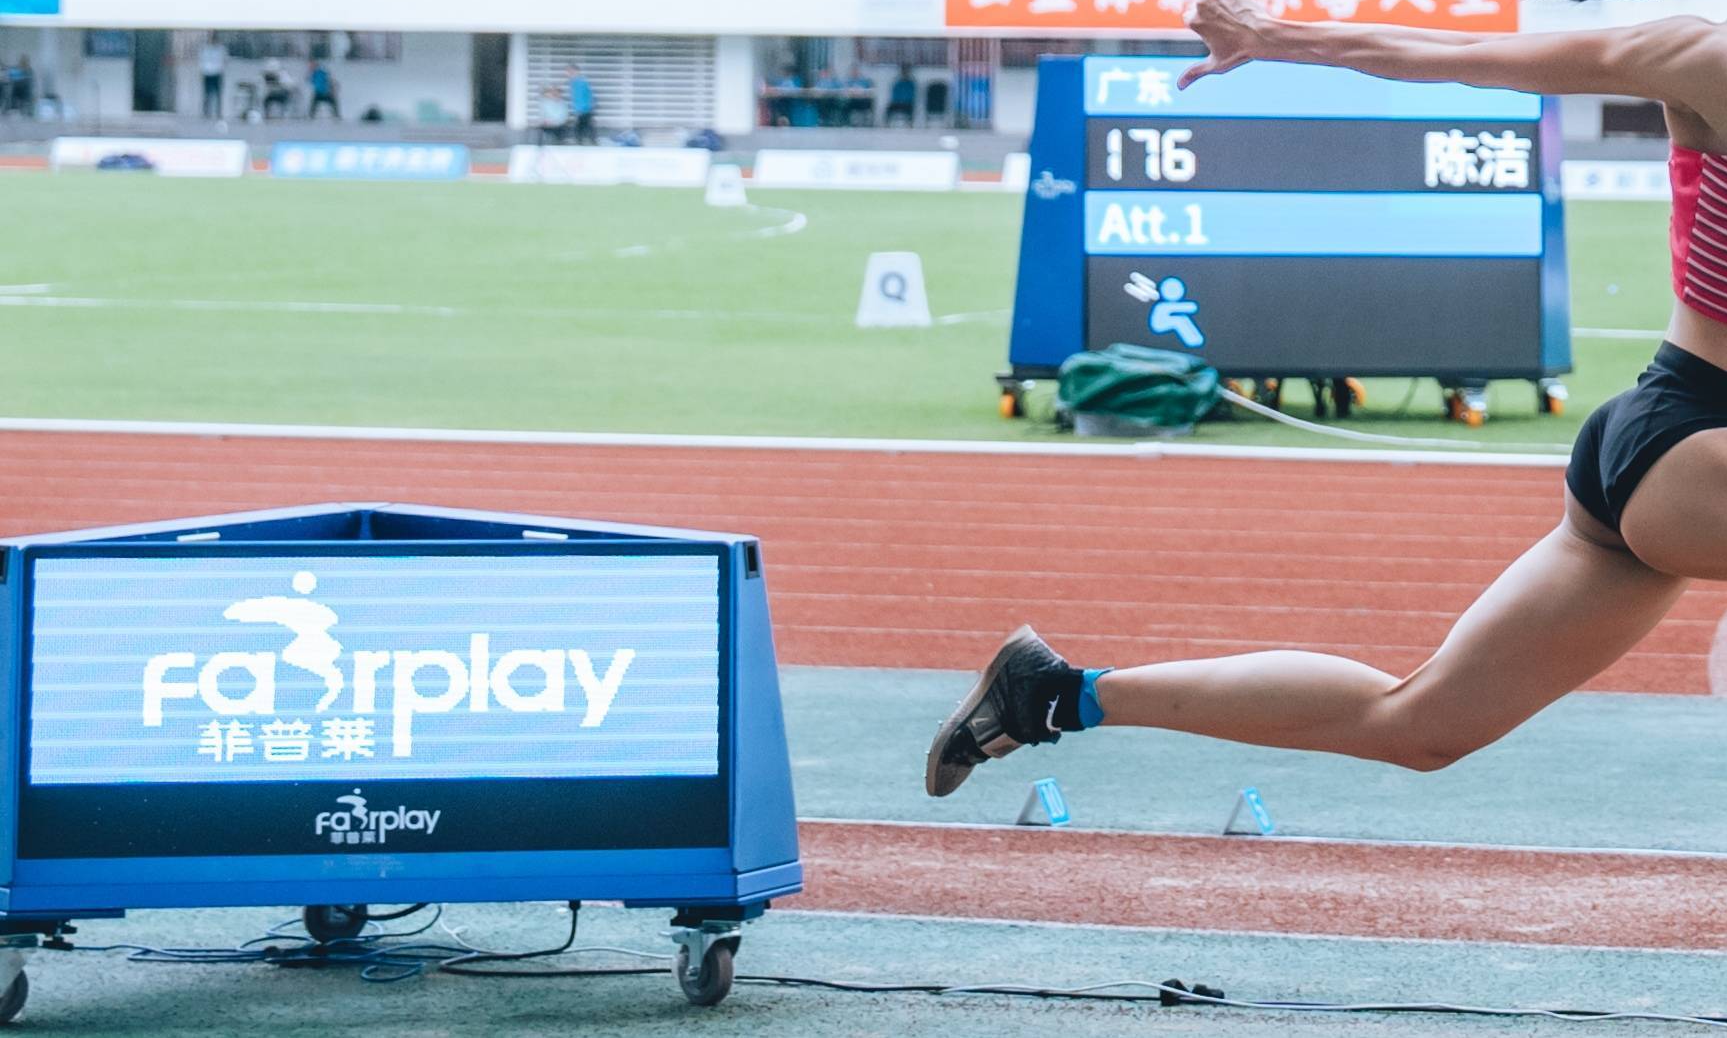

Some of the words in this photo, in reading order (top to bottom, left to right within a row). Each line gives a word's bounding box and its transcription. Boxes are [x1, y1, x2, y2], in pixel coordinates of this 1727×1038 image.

[1098, 67, 1173, 105] 广东
[1106, 129, 1197, 182] 176
[1424, 129, 1532, 188] 陈洁
[1098, 203, 1208, 245] Att.1
[880, 271, 908, 303] Q
